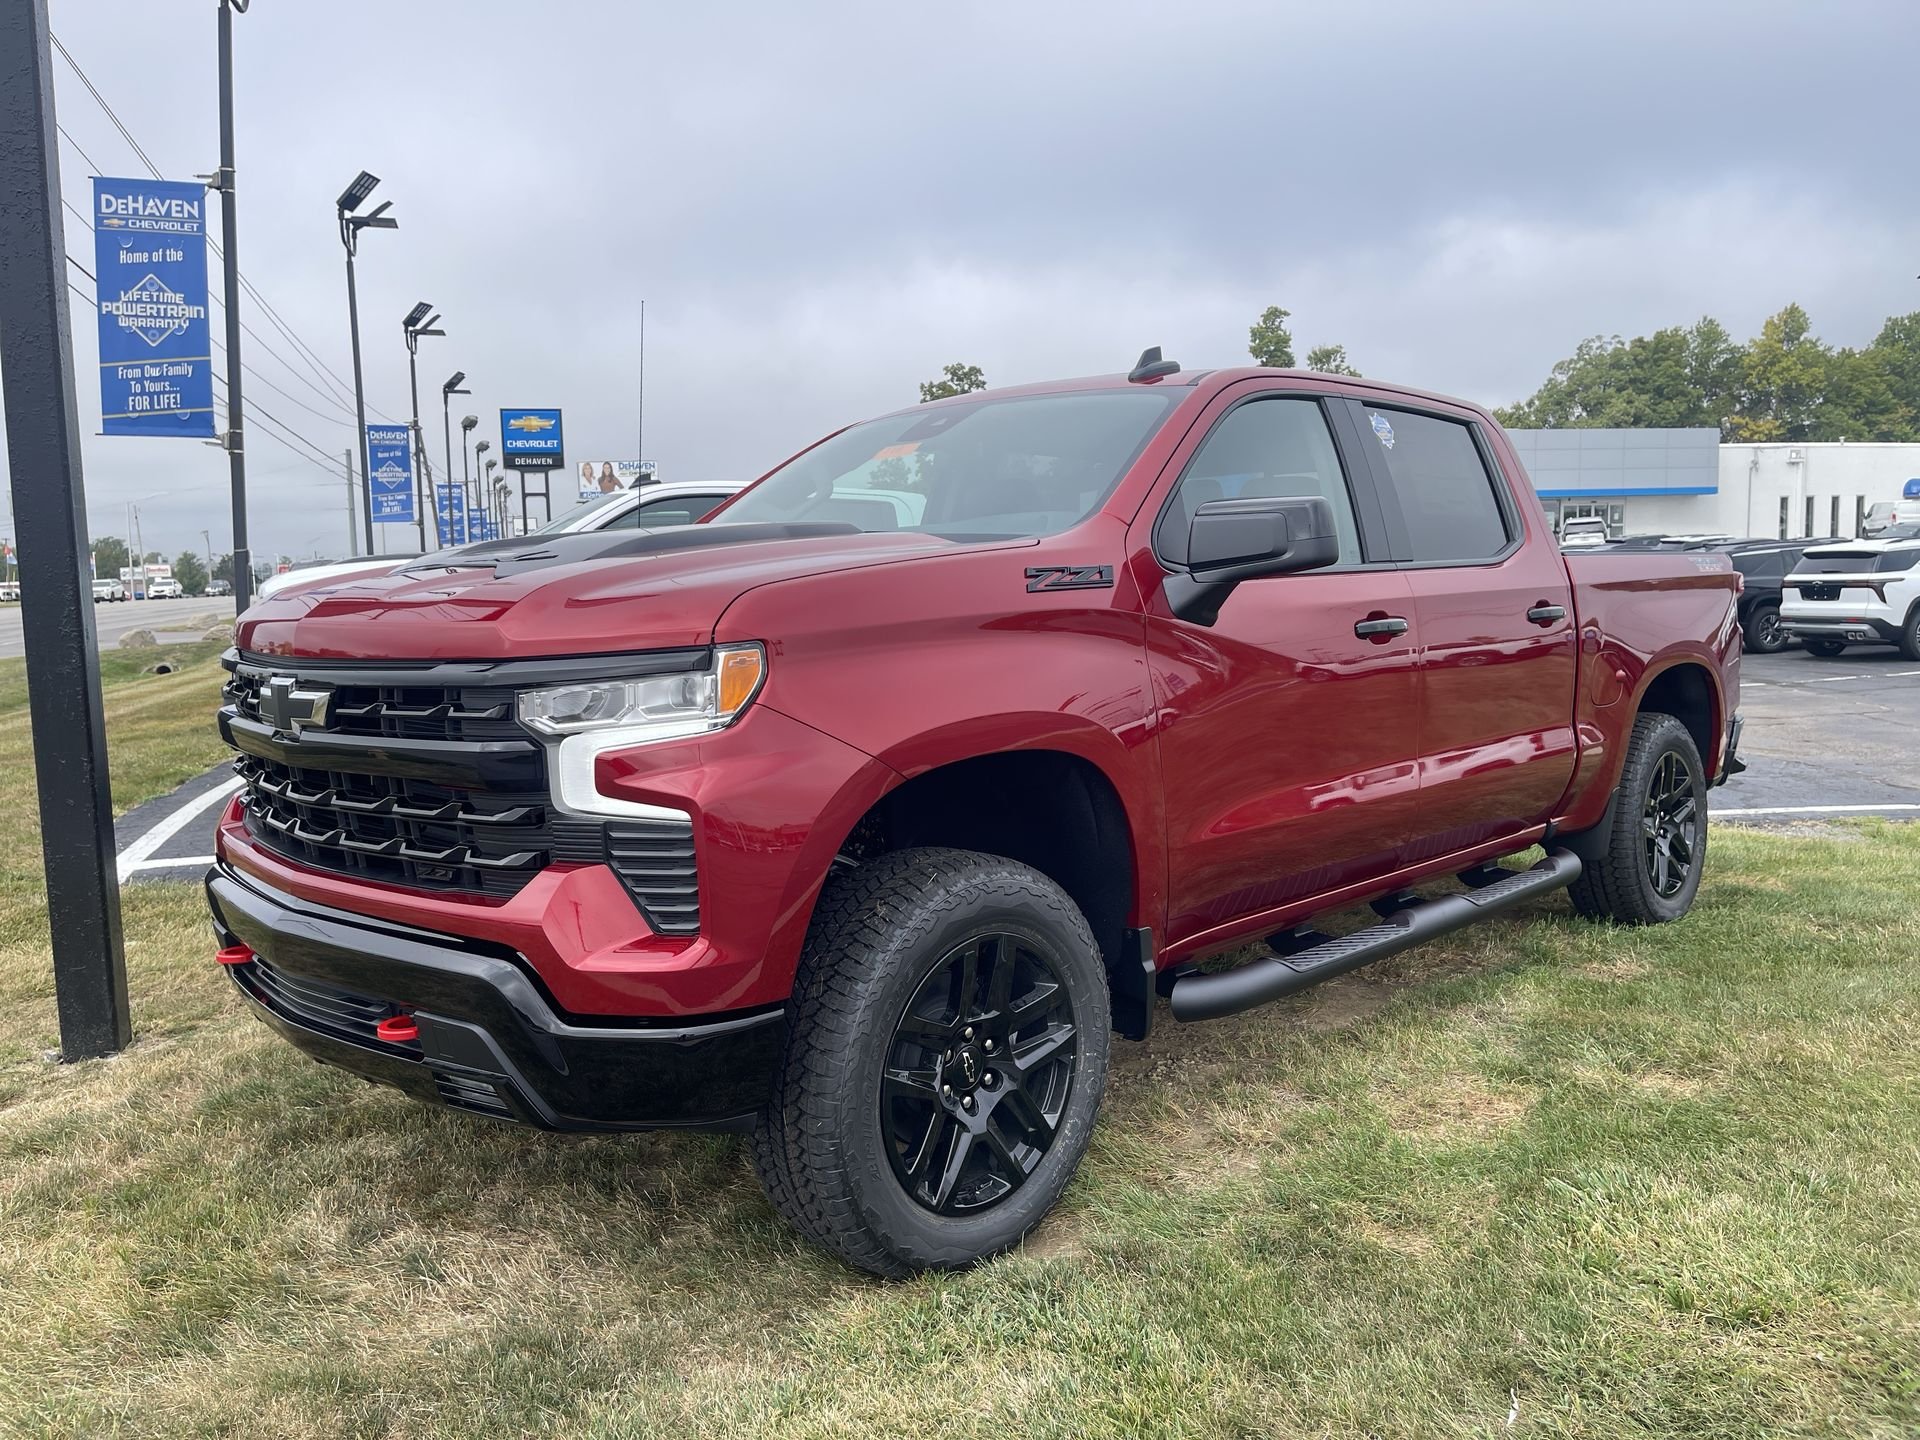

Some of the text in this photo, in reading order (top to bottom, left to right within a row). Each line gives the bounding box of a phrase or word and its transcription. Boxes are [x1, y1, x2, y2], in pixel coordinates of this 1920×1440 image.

[128, 219, 200, 232] CHEVROLET
[119, 247, 183, 264] Home of the
[120, 290, 185, 304] LIFETIME
[101, 301, 205, 319] POWERTRAIN
[118, 315, 190, 329] WARRANTY
[118, 366, 142, 379] From
[162, 362, 193, 378] Family
[130, 381, 141, 393] To
[128, 393, 181, 411] FOR LIFE!
[507, 439, 559, 448] CHEVROLET
[515, 457, 553, 465] DEHAVEN
[1024, 565, 1114, 593] Z71
